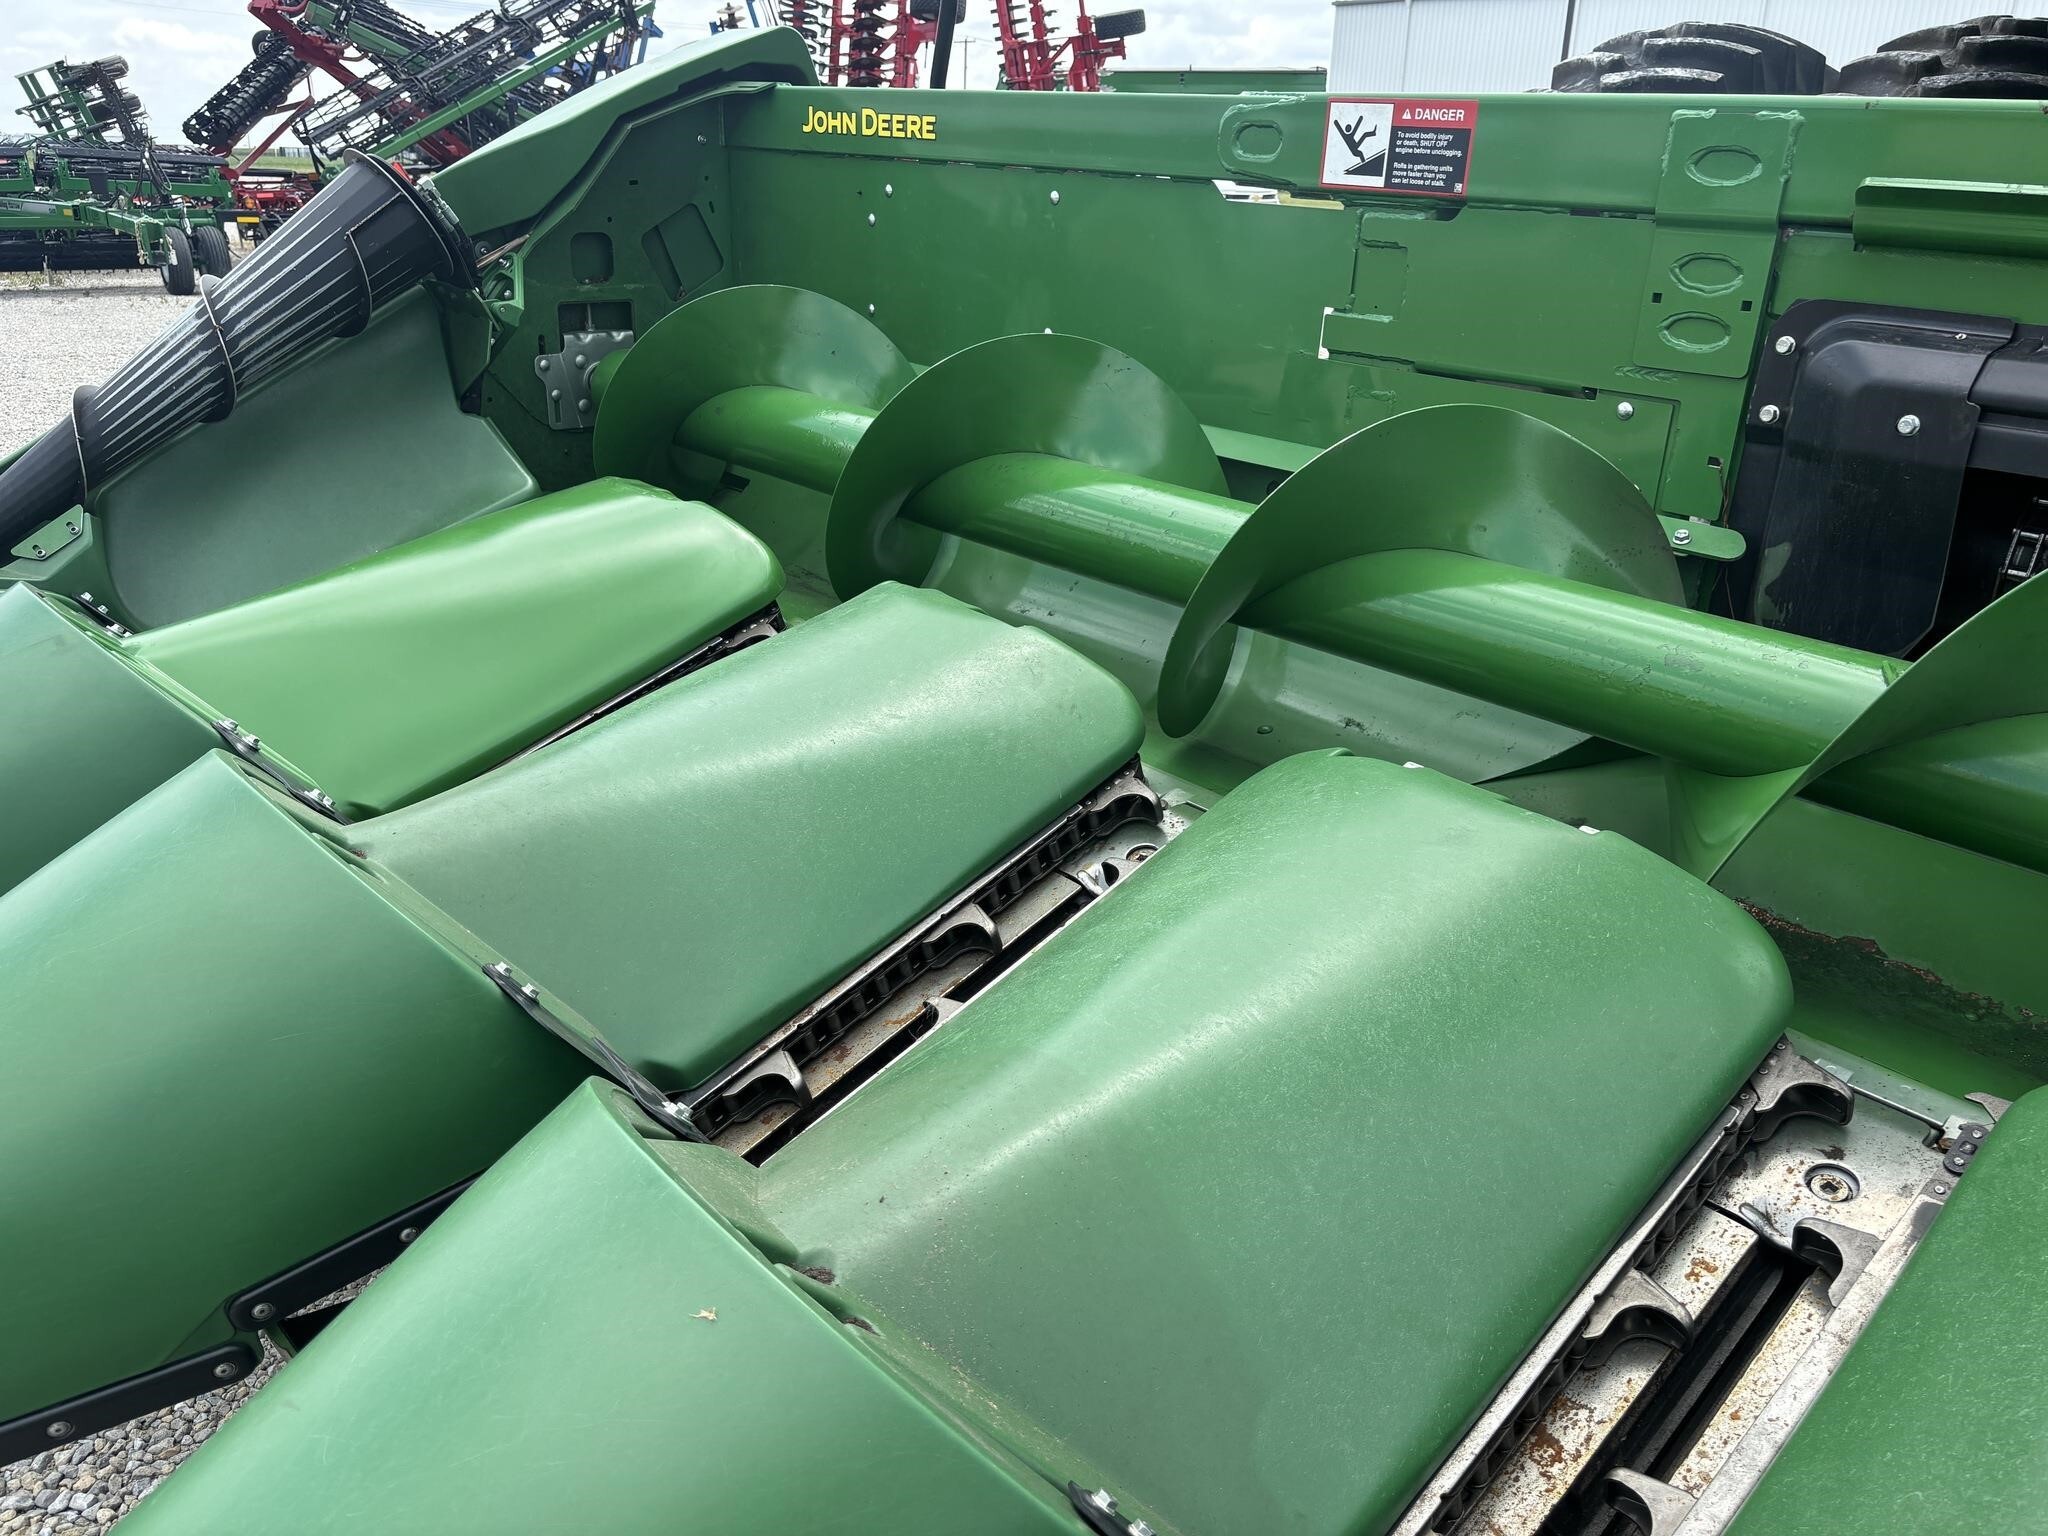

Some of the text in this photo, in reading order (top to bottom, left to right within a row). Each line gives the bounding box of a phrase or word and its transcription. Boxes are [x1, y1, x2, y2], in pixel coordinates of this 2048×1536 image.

[1414, 108, 1465, 122] DANGER
[803, 105, 936, 139] JOHN DEERE
[1420, 132, 1437, 140] bodily
[1438, 133, 1454, 141] injury
[1395, 147, 1413, 155] engine
[1431, 148, 1462, 158] unclogging.
[1413, 163, 1439, 172] gathering
